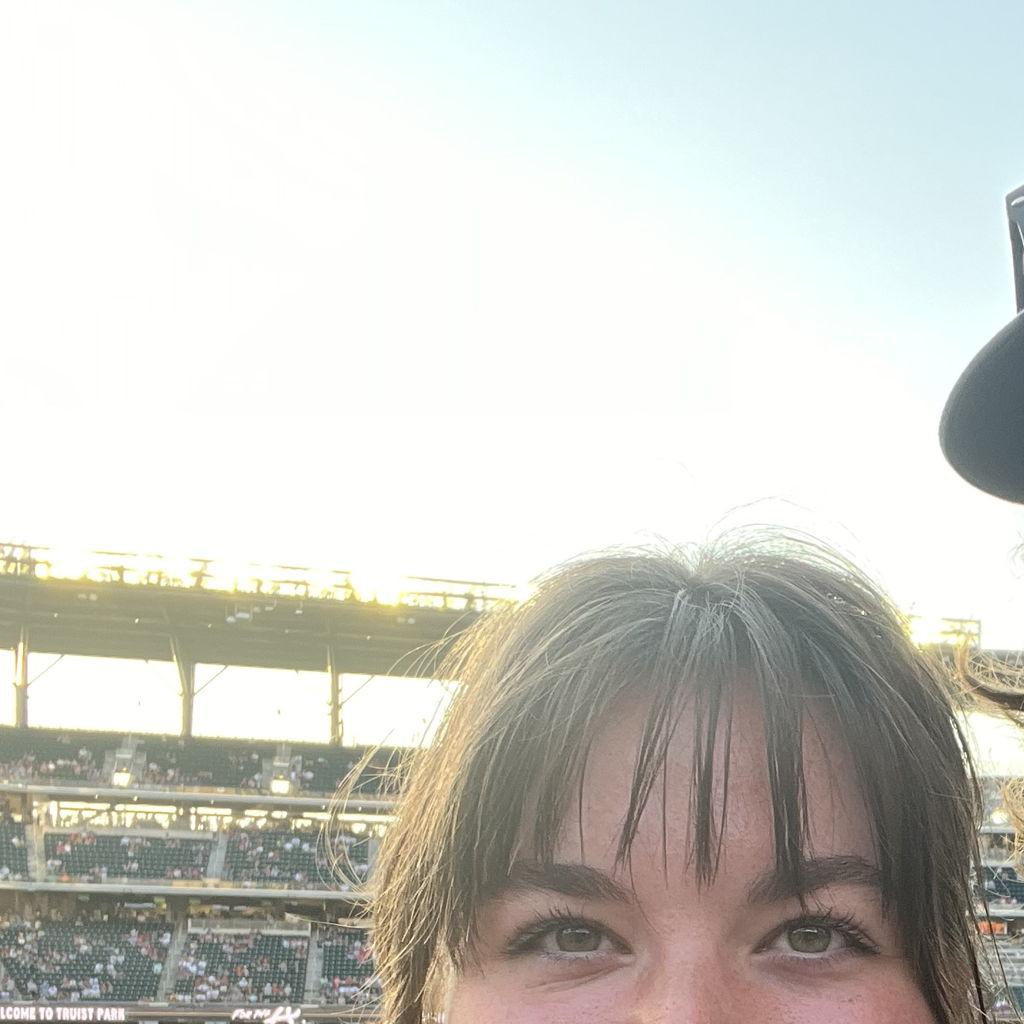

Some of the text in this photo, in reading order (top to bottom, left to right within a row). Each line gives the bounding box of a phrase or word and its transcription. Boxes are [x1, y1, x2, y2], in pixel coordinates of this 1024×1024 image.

[39, 1007, 54, 1020] TO
[56, 1007, 94, 1020] TRUIST
[97, 1007, 125, 1021] PARK
